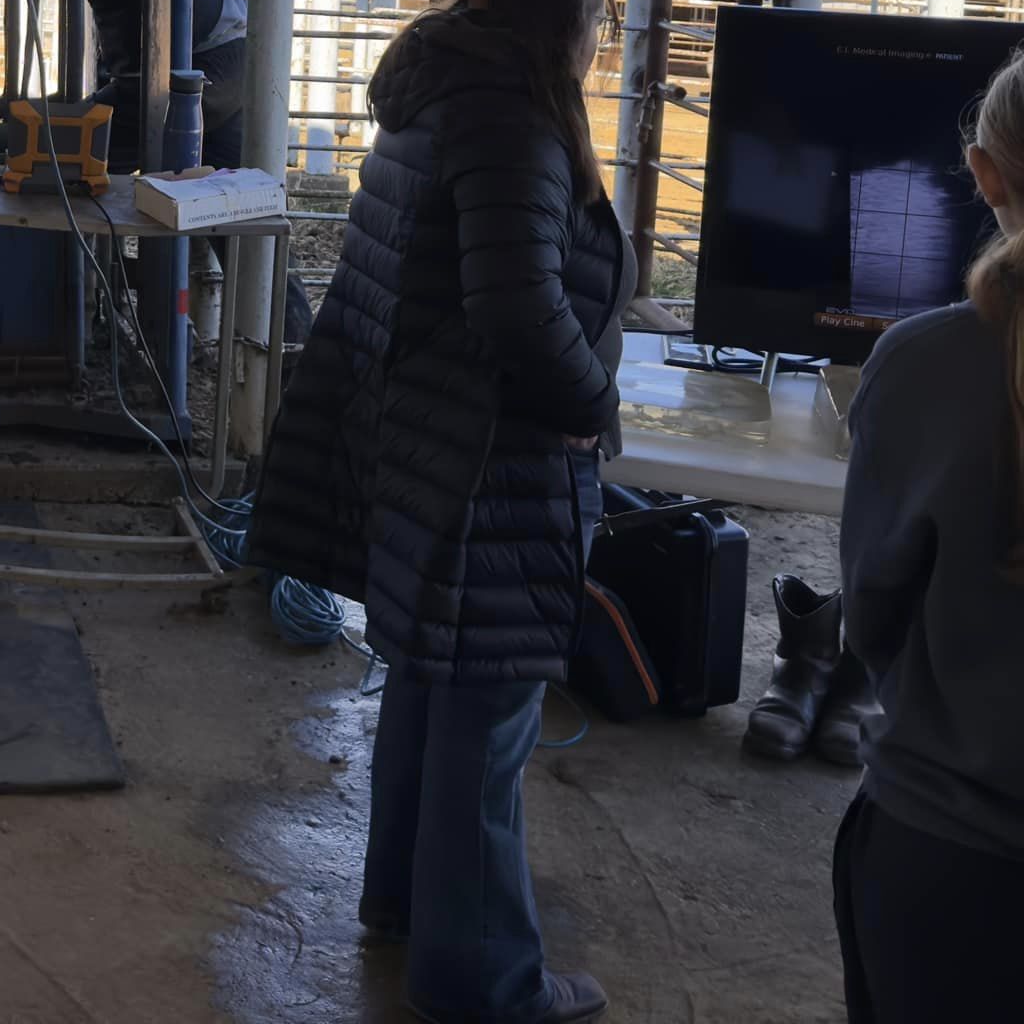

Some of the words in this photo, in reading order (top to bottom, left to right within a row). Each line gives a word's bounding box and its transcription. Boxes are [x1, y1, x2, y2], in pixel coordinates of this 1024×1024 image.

[852, 47, 887, 57] Medical
[888, 48, 924, 60] Imaging
[820, 315, 841, 327] Play
[843, 318, 865, 328] Cine
